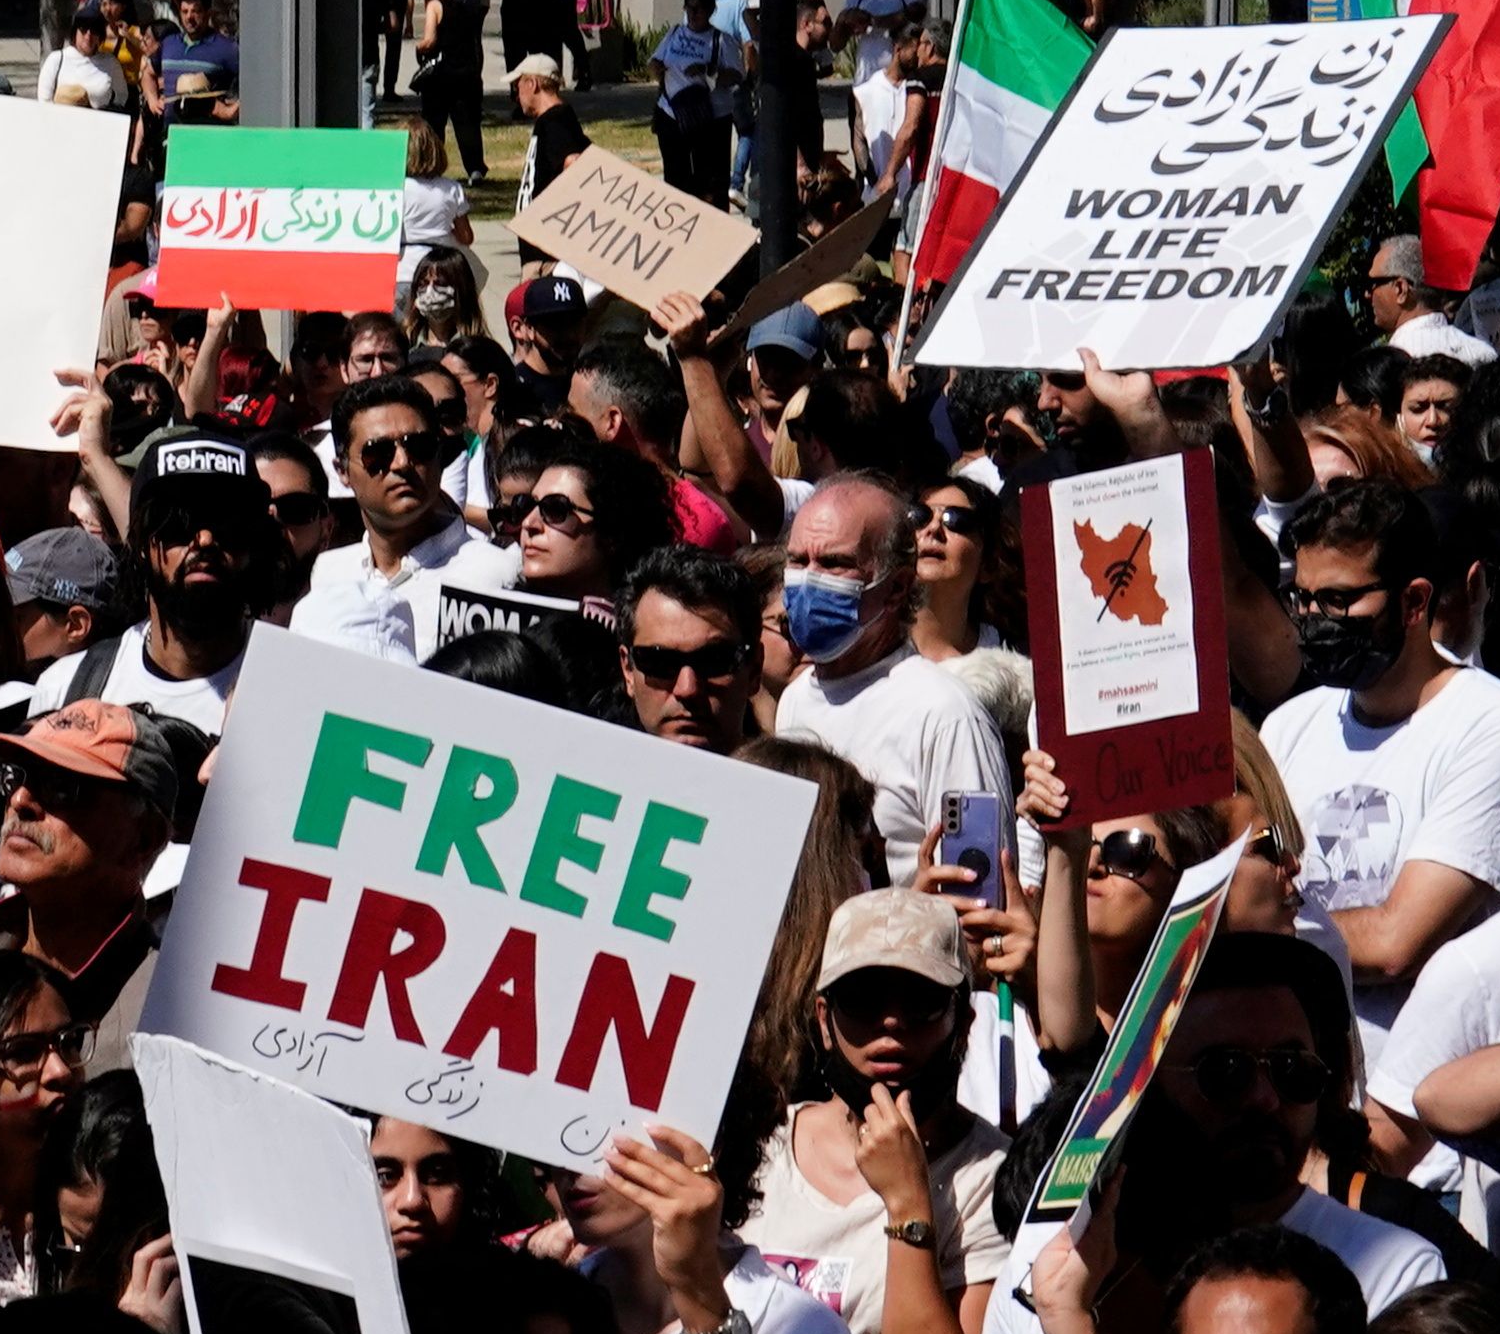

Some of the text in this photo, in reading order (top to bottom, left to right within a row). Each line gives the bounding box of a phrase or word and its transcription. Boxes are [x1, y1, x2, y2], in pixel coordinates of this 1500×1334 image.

[1093, 35, 1305, 126] آزادی
[1310, 28, 1405, 90] زن
[1151, 87, 1376, 176] زندگی
[166, 185, 401, 243] زن زندگی آزادی
[579, 166, 701, 244] MAHSA
[1064, 184, 1304, 220] WOMAN
[541, 200, 675, 281] AMINI
[1088, 227, 1228, 260] LIFE
[986, 264, 1288, 301] FREEDOM
[1084, 472, 1136, 492] Islamic Republic
[1098, 679, 1159, 701] #mahsaamini
[1095, 736, 1232, 803] Our Voice
[291, 711, 709, 943] FREE
[210, 857, 697, 1114] IRAN
[251, 1023, 486, 1120] آزادی زندگی
